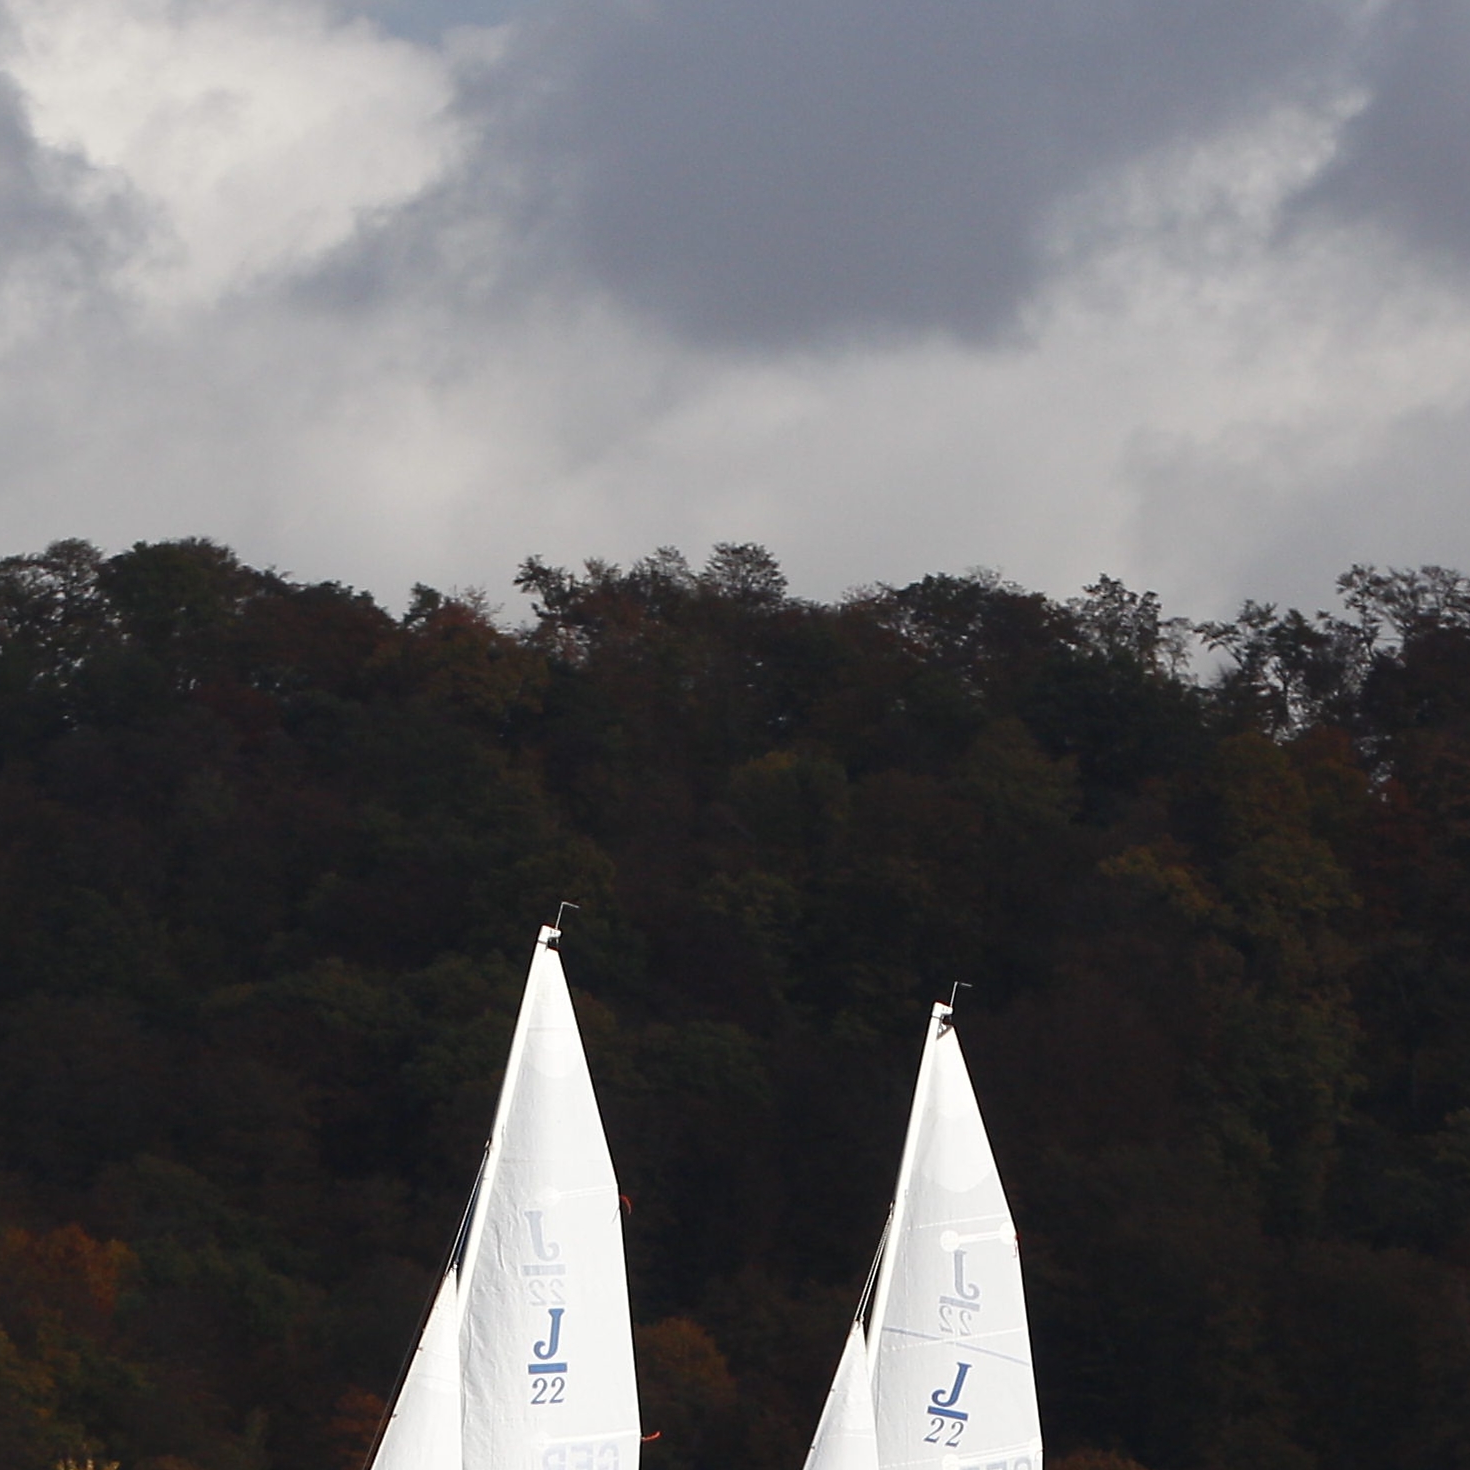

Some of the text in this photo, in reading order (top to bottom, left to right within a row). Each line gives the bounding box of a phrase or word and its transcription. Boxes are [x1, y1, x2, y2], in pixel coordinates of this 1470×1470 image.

[533, 1308, 565, 1360] J
[530, 1376, 565, 1405] 22
[931, 1361, 972, 1408] J
[924, 1417, 964, 1448] 22
